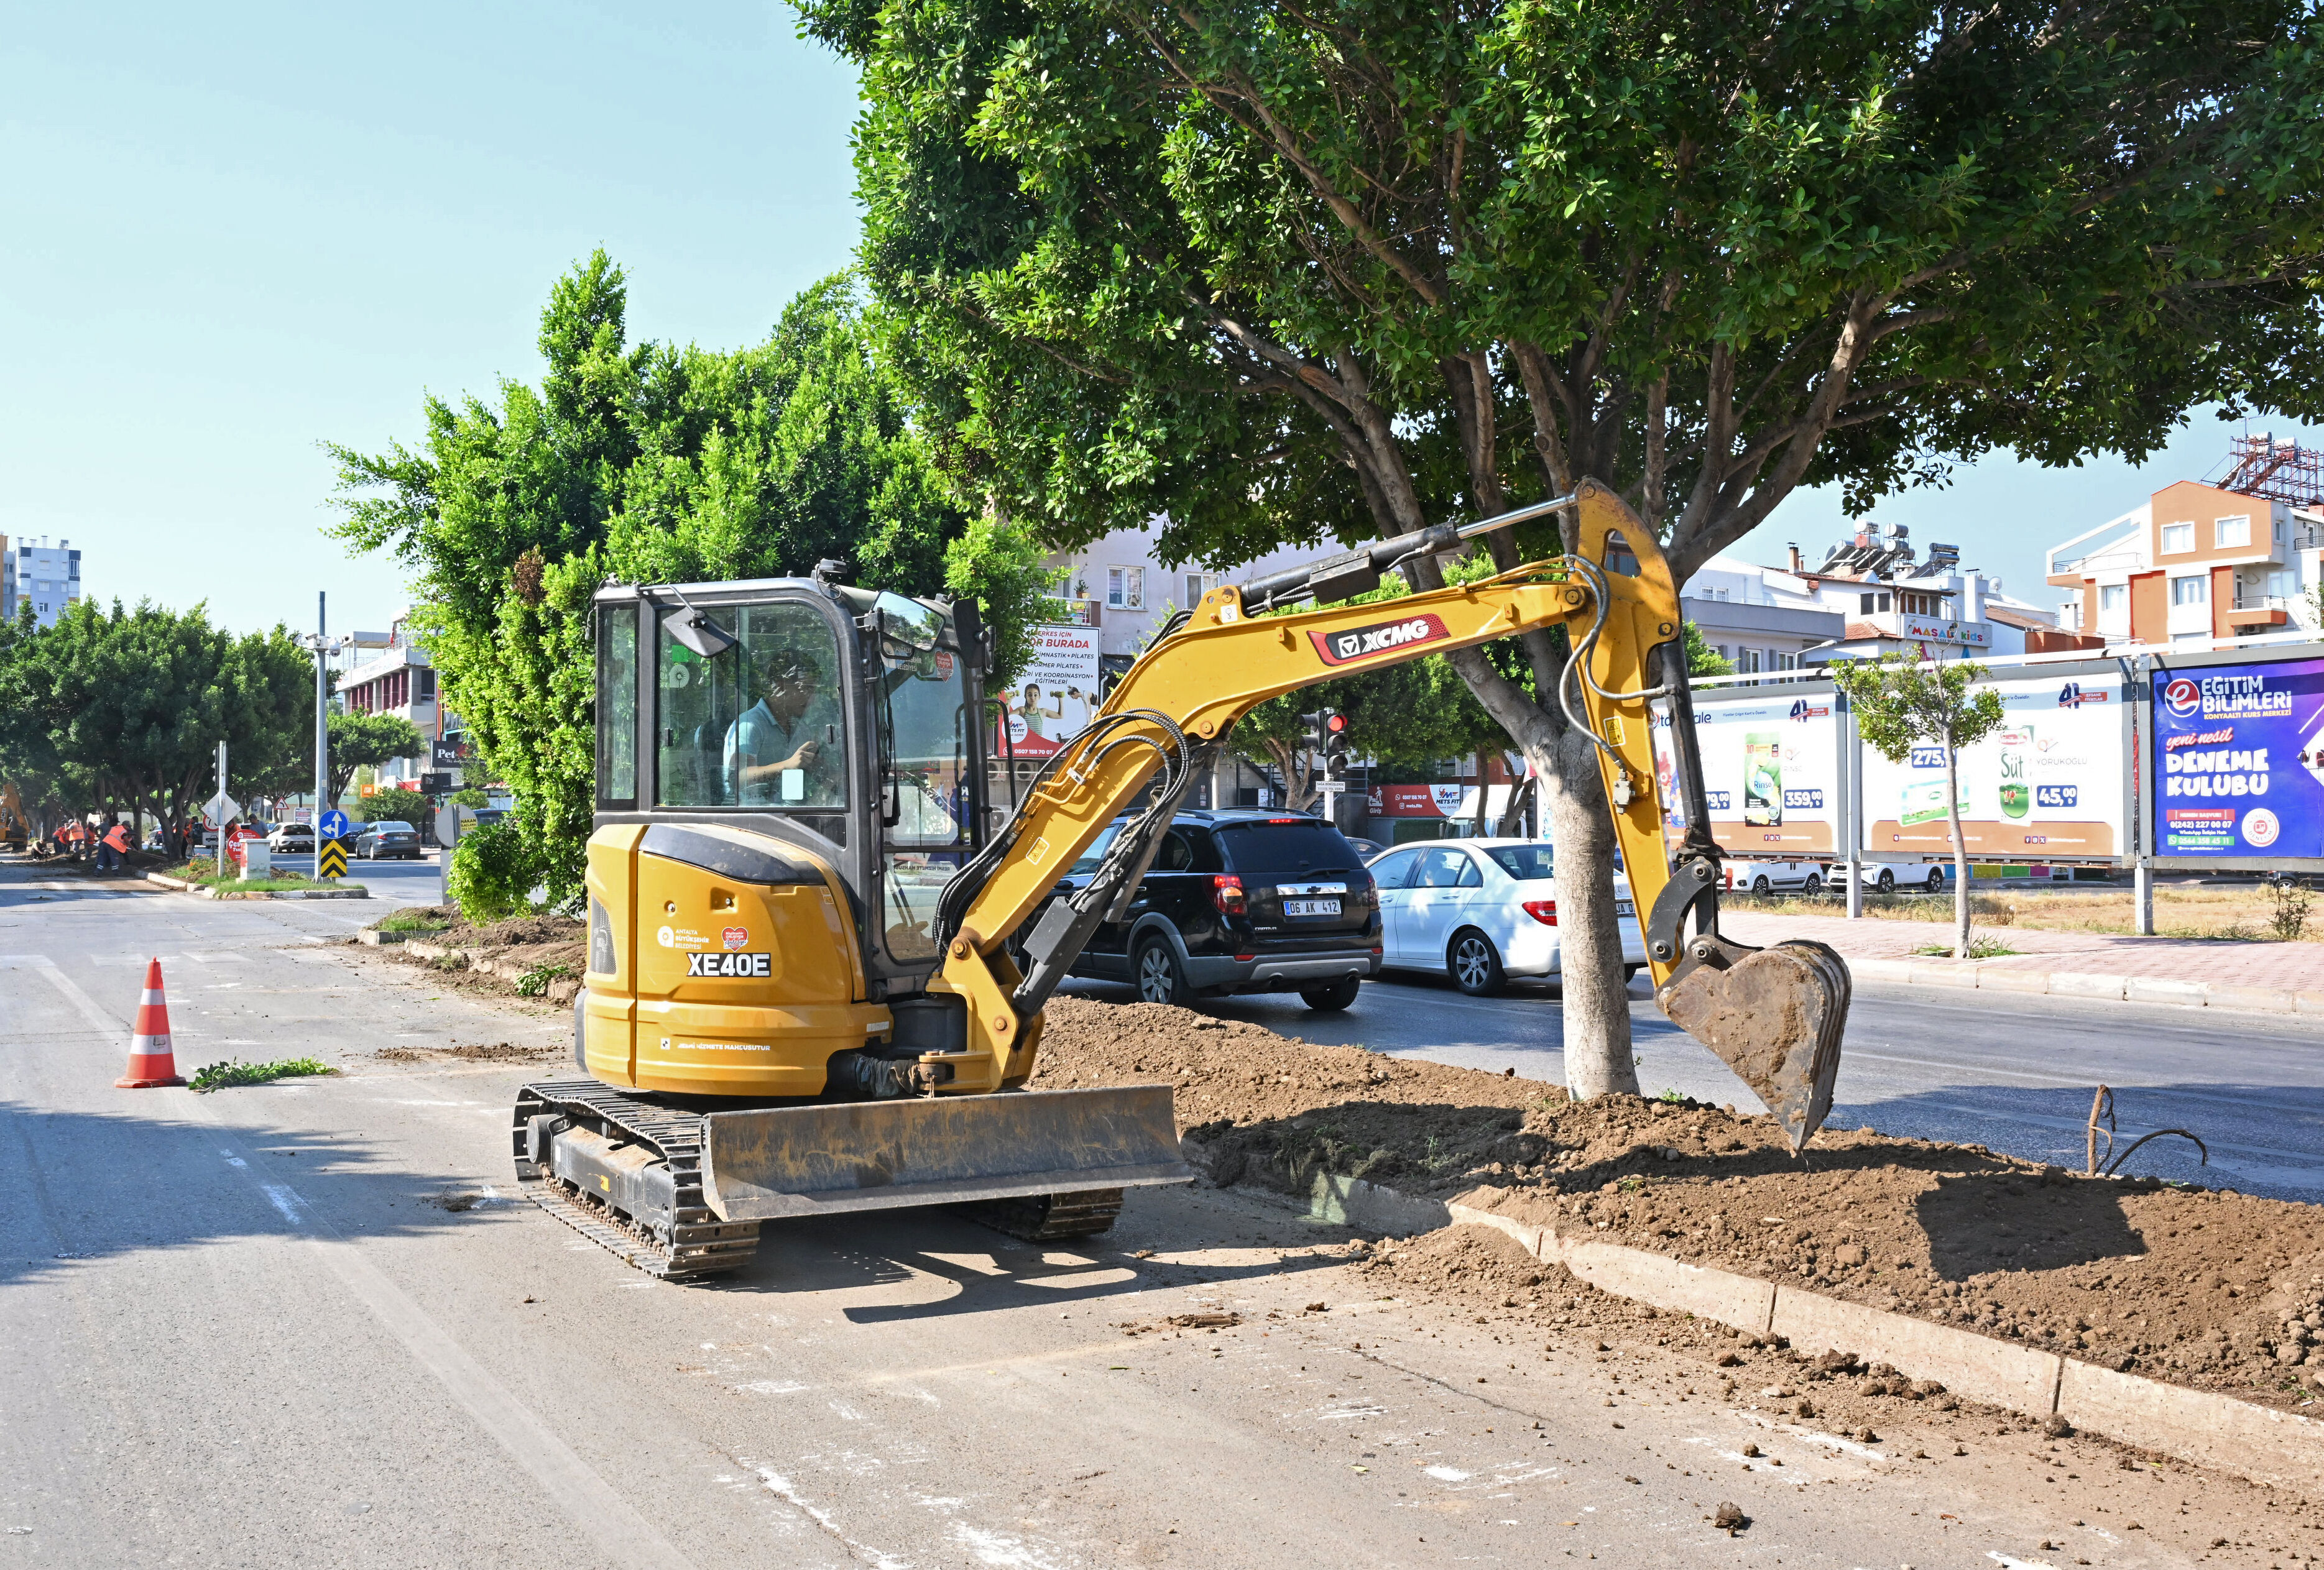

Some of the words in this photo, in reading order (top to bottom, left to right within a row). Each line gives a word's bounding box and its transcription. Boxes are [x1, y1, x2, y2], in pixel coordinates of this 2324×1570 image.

[1046, 638, 1089, 649] BURADA
[1362, 619, 1429, 653] XCMG
[1961, 630, 1983, 641] kids
[2201, 675, 2264, 695] EĞİTİM
[2202, 691, 2292, 713] BİLİMLERİ
[2166, 732, 2197, 751] yeni
[2197, 727, 2234, 745] nesil
[438, 748, 456, 758] Pet
[1746, 744, 1755, 754] 10
[2001, 753, 2024, 779] Süt
[2165, 748, 2270, 773] DENEME
[1754, 781, 1772, 789] Rinso
[1786, 791, 1823, 808] 359,00
[2039, 787, 2077, 807] 45,00
[2170, 820, 2194, 829] 0(242)
[2195, 820, 2210, 829] 227
[2210, 820, 2221, 829] 00
[2221, 820, 2233, 829] 07
[1289, 902, 1301, 914] 06
[1306, 902, 1316, 913] AK
[1322, 902, 1339, 912] 412
[675, 935, 710, 943] BÜYÜKŞEHİR
[686, 953, 770, 977] XE40E
